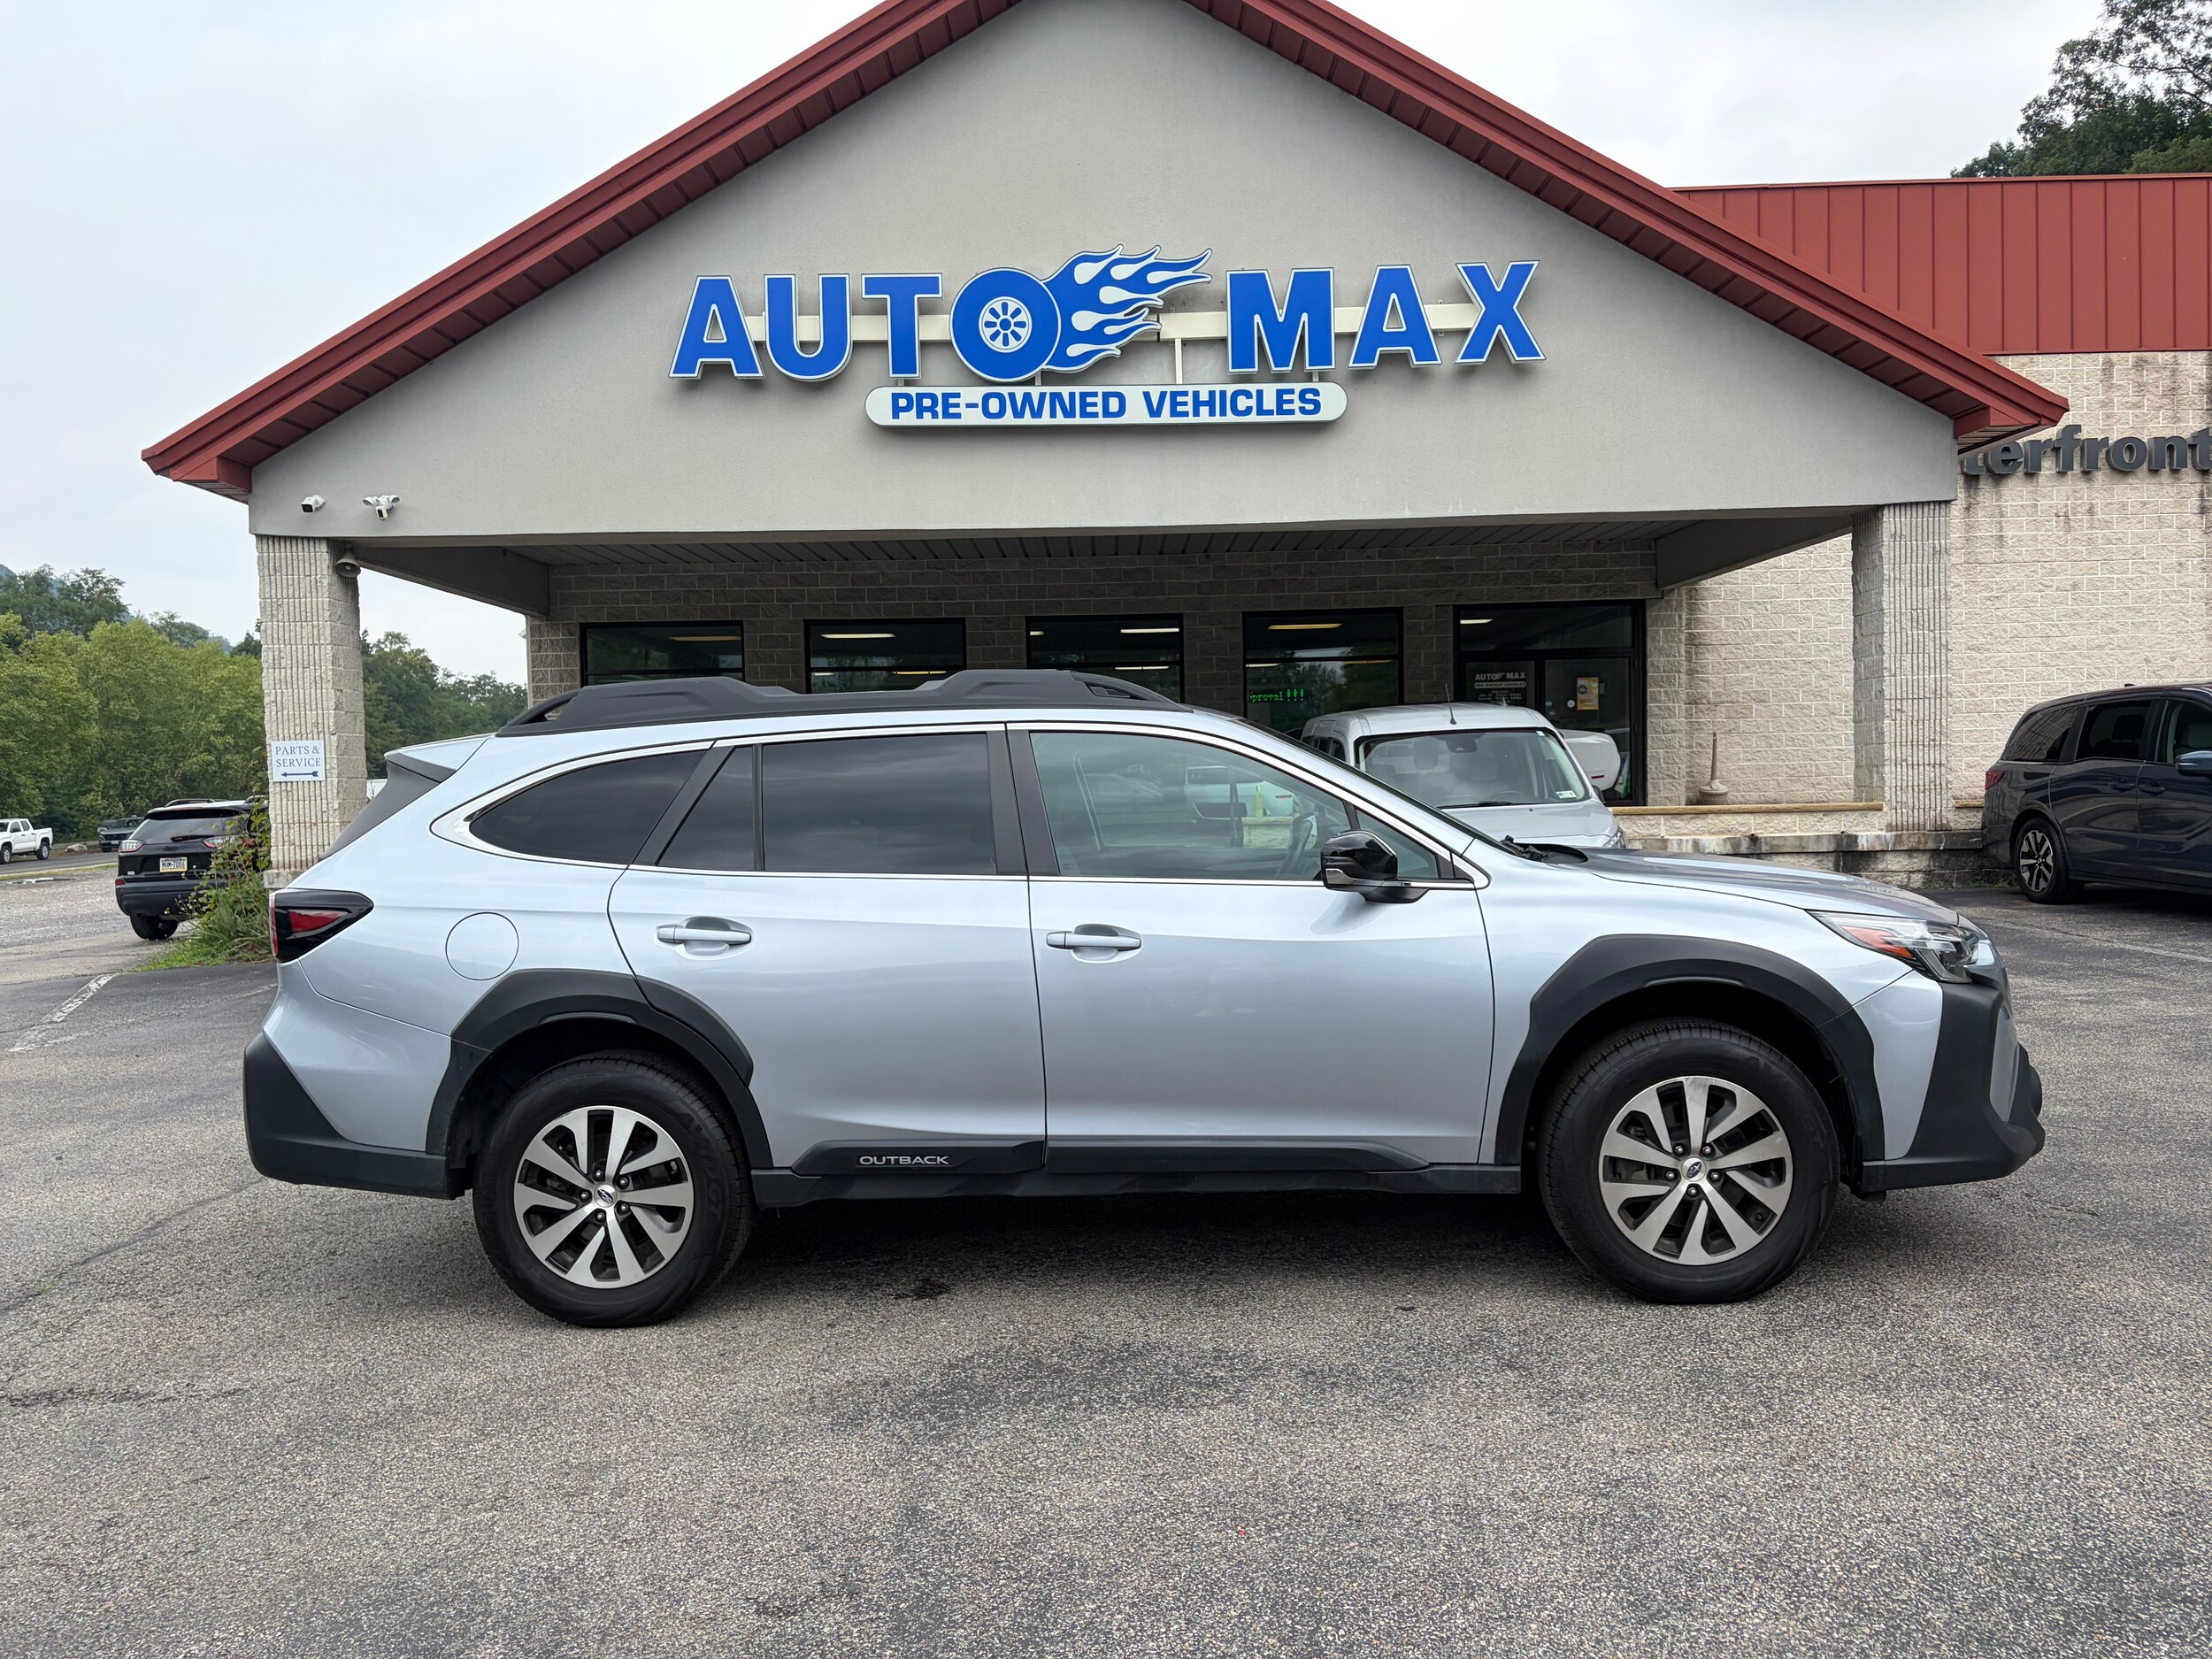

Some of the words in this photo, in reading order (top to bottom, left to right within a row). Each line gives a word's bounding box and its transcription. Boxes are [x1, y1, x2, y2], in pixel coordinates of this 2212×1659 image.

[668, 267, 1062, 382] AUTO
[1226, 260, 1546, 374] MAX
[890, 390, 1126, 420] PRE-OWNED
[1141, 388, 1322, 419] VEHICLES
[275, 745, 310, 756] PARTS
[311, 745, 320, 755] &
[275, 757, 321, 768] SERVICE
[858, 1155, 949, 1165] OUTBACK
